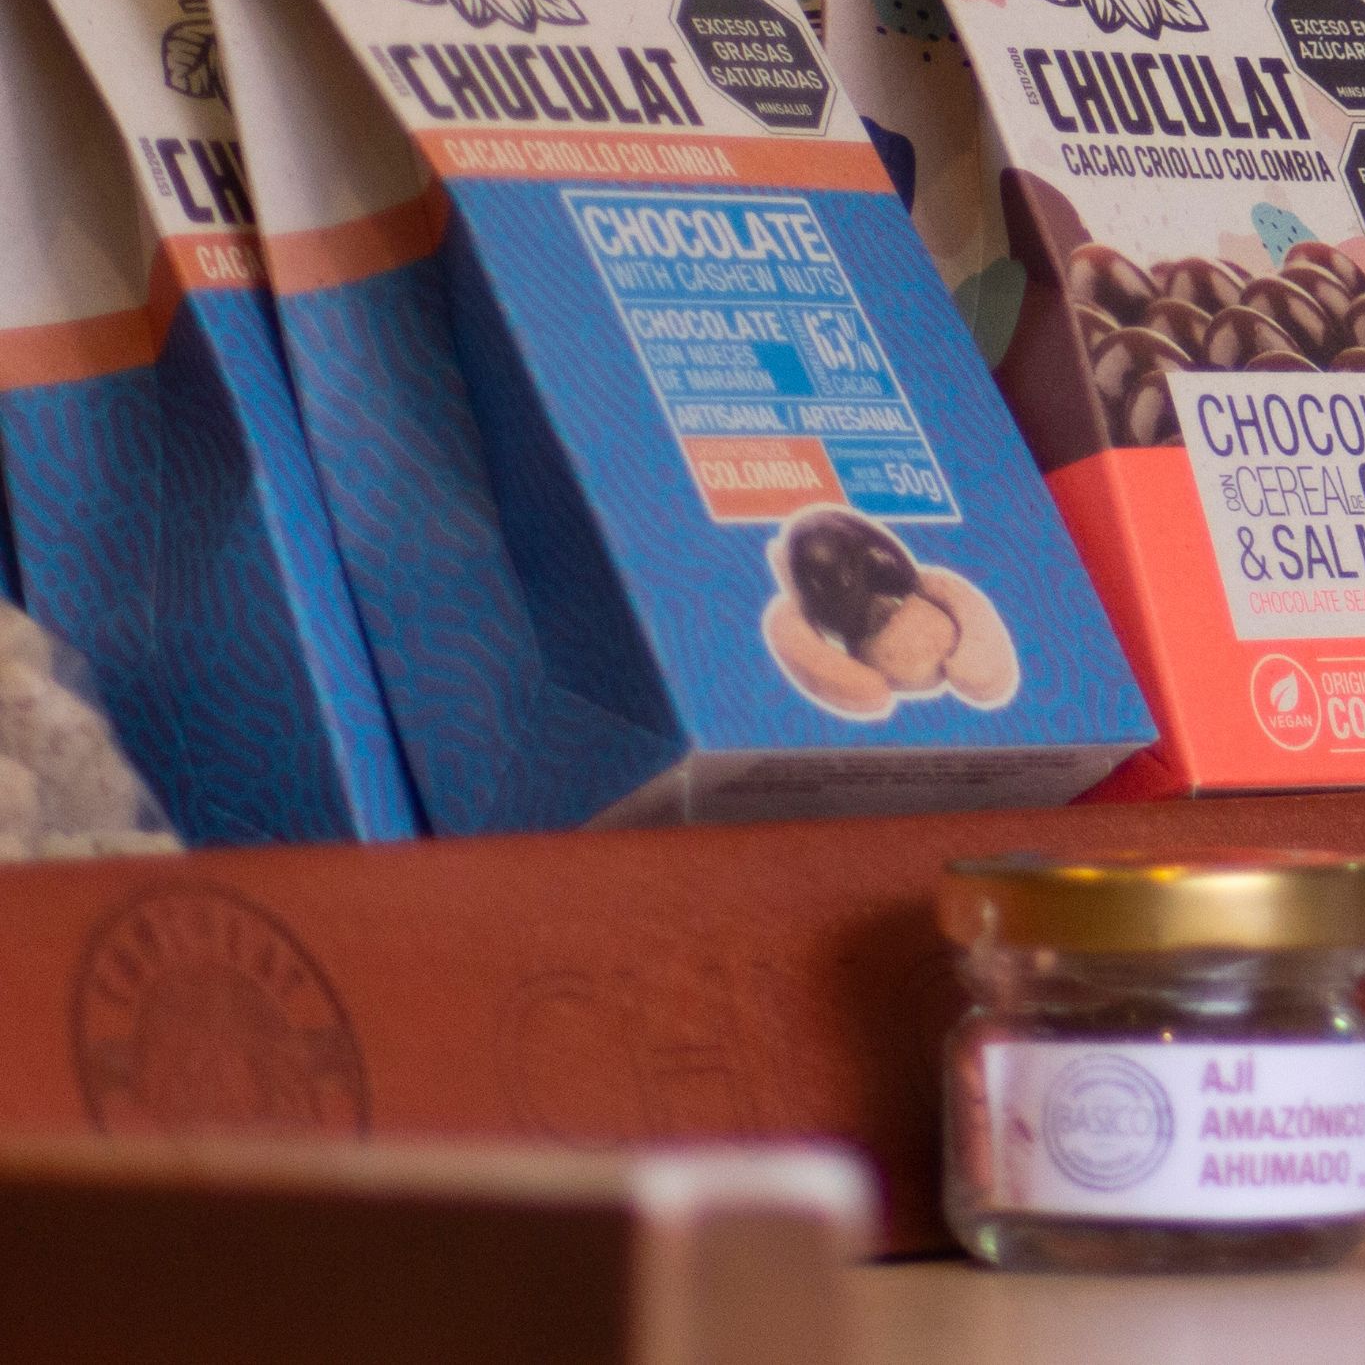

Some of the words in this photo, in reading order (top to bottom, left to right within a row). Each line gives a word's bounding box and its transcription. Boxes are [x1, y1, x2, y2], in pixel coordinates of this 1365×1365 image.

[693, 18, 759, 38] EXCESO
[763, 20, 787, 39] EN
[1291, 18, 1347, 36] EXCESO
[712, 41, 795, 65] GRASAS
[388, 43, 705, 127] CHUCULAT
[710, 65, 824, 91] SATURADAS
[1023, 48, 1312, 141] CHUCULAT
[755, 101, 813, 117] MINSALUD
[443, 138, 527, 172] CACAO
[529, 140, 618, 174] CRIOLLO
[620, 142, 738, 178] COLOMBIA
[1061, 143, 1136, 177] CACAO
[1136, 145, 1224, 181] CRIOLLO
[1223, 147, 1336, 183] COLOMBIA
[583, 205, 834, 263] CHOCOLATE
[675, 263, 777, 293] CASHEW
[777, 265, 848, 296] NUTS
[630, 308, 789, 342] CHOCOLATE
[699, 459, 824, 490] COLOMBIA
[884, 461, 942, 503] 50g
[1220, 473, 1241, 512] CON
[1235, 465, 1353, 518] CEREAL
[1351, 495, 1365, 514] DE
[1238, 524, 1273, 582] &
[1273, 523, 1359, 581] SAL
[1249, 589, 1341, 616] CHOCOLATE
[1268, 713, 1313, 729] VEGAN
[1201, 1050, 1256, 1094] AJÍ
[1199, 1150, 1350, 1188] AHUMADO
